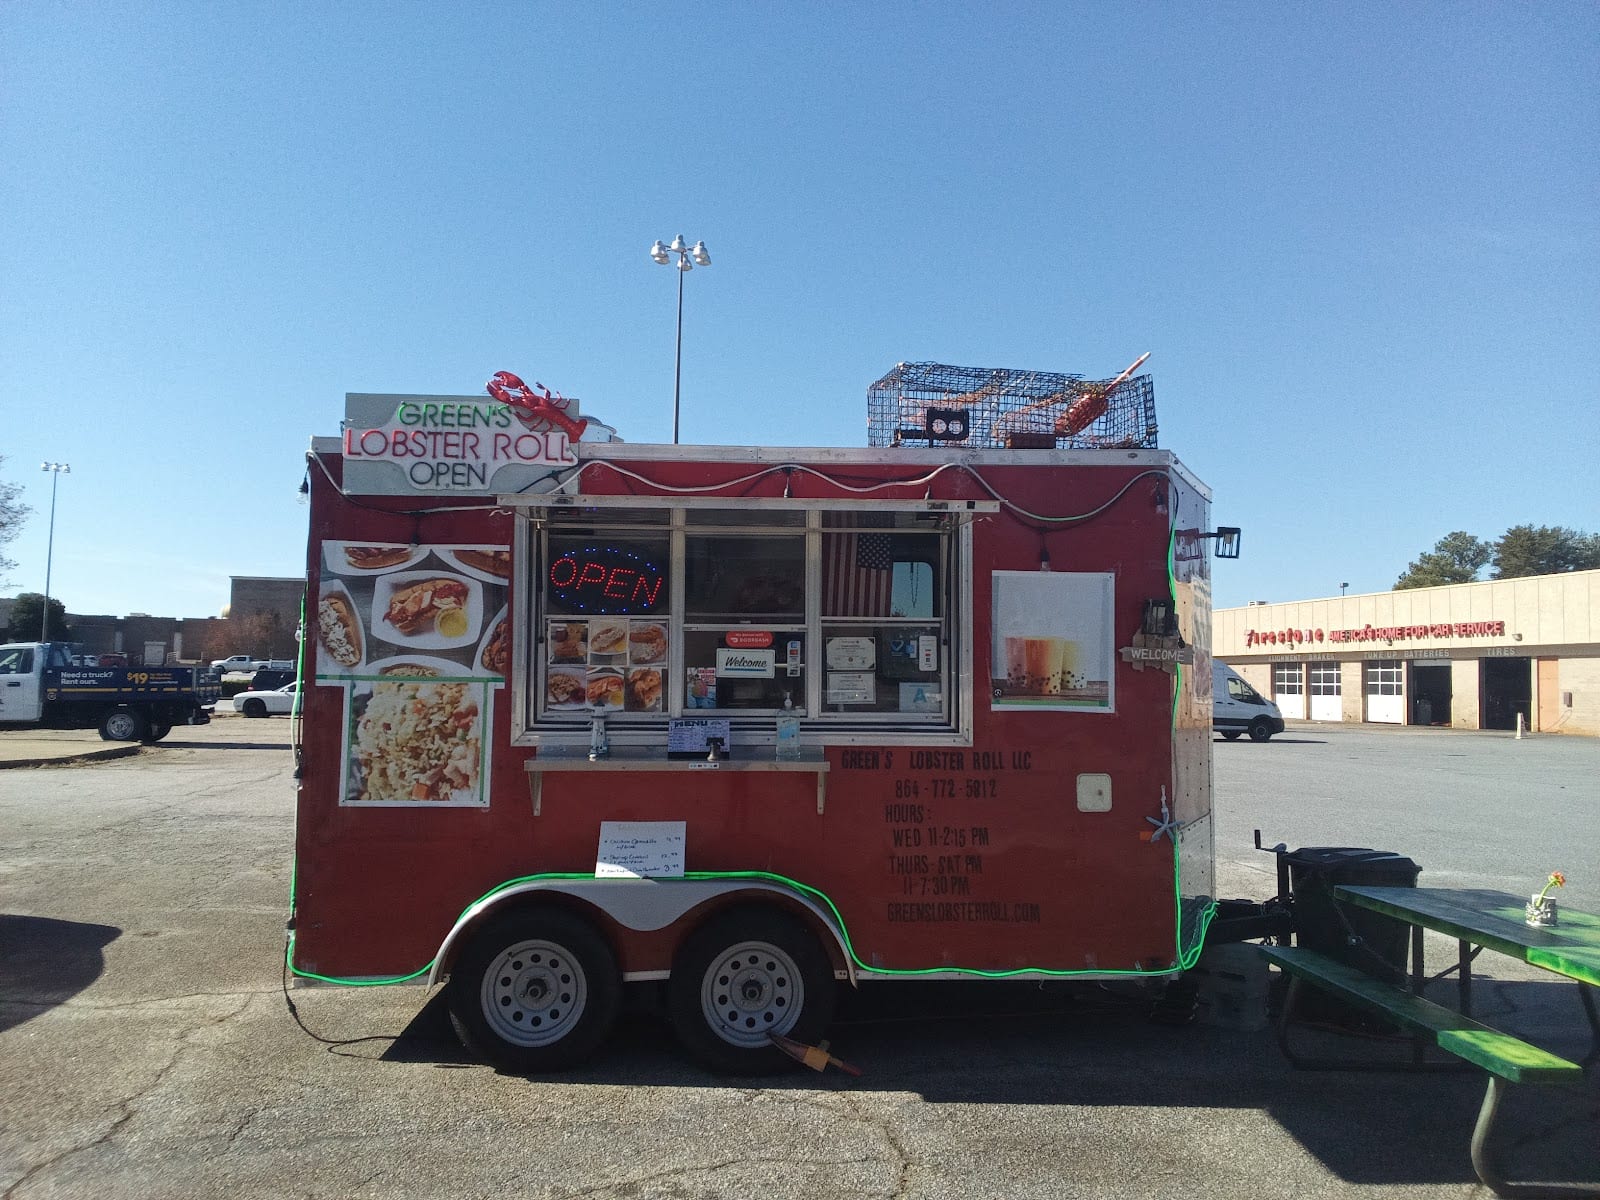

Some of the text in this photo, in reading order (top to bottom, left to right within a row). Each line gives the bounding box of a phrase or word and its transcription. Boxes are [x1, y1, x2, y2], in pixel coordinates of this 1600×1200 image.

[397, 402, 512, 428] GREEN'S
[345, 429, 575, 464] LOBSTER ROLL
[410, 461, 487, 487] OPEN
[550, 557, 663, 605] OPEN
[1375, 627, 1401, 639] HOME
[1404, 625, 1425, 637] FOR
[1428, 623, 1450, 636] CAR
[1453, 620, 1503, 635] SERVICE
[1131, 648, 1185, 661] WELCOME
[1404, 650, 1450, 658] BATTERIES
[1487, 647, 1516, 656] TIRES
[725, 656, 768, 668] Welcome
[127, 672, 149, 685] $19
[910, 751, 964, 770] LOBSTER
[973, 751, 1005, 770] ROLL
[1012, 751, 1031, 770] LLC
[893, 828, 921, 847] WED
[972, 827, 989, 846] PM
